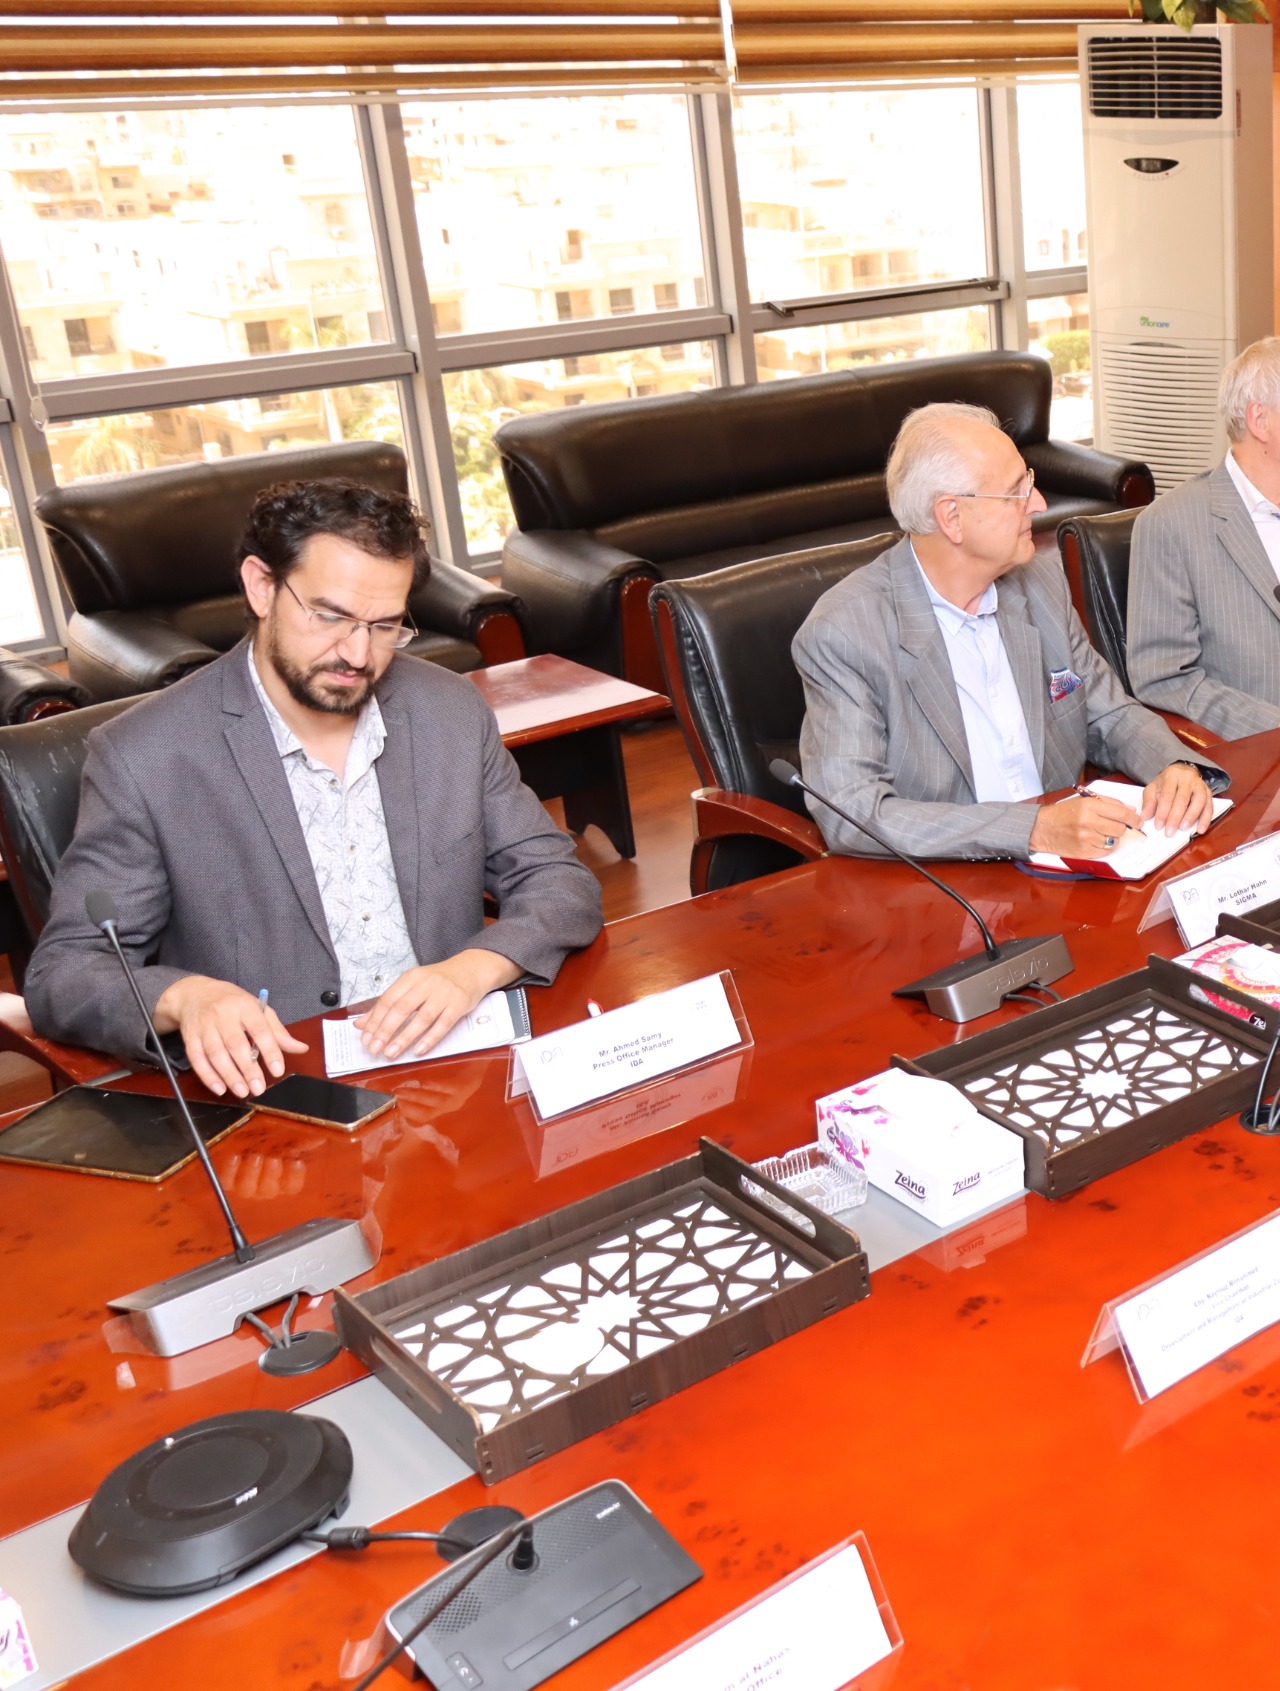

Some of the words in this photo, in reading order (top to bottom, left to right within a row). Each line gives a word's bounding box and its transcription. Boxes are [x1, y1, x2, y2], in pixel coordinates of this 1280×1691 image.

[1217, 896, 1229, 904] Mr.
[1229, 887, 1250, 899] Lothar
[1250, 879, 1267, 890] Hahn
[1235, 892, 1257, 905] SIGMA
[592, 1059, 615, 1070] Press
[616, 1050, 640, 1061] Office
[641, 1038, 674, 1053] Manager
[598, 1049, 611, 1057] Mr.
[613, 1038, 640, 1053] Ahmed
[641, 1032, 662, 1043] Samy
[630, 1058, 644, 1068] IDA
[895, 1169, 927, 1200] Zeina
[952, 1171, 981, 1197] Zeina
[1197, 1321, 1206, 1331] and
[1206, 1302, 1240, 1324] Management
[753, 1647, 791, 1674] Nahas
